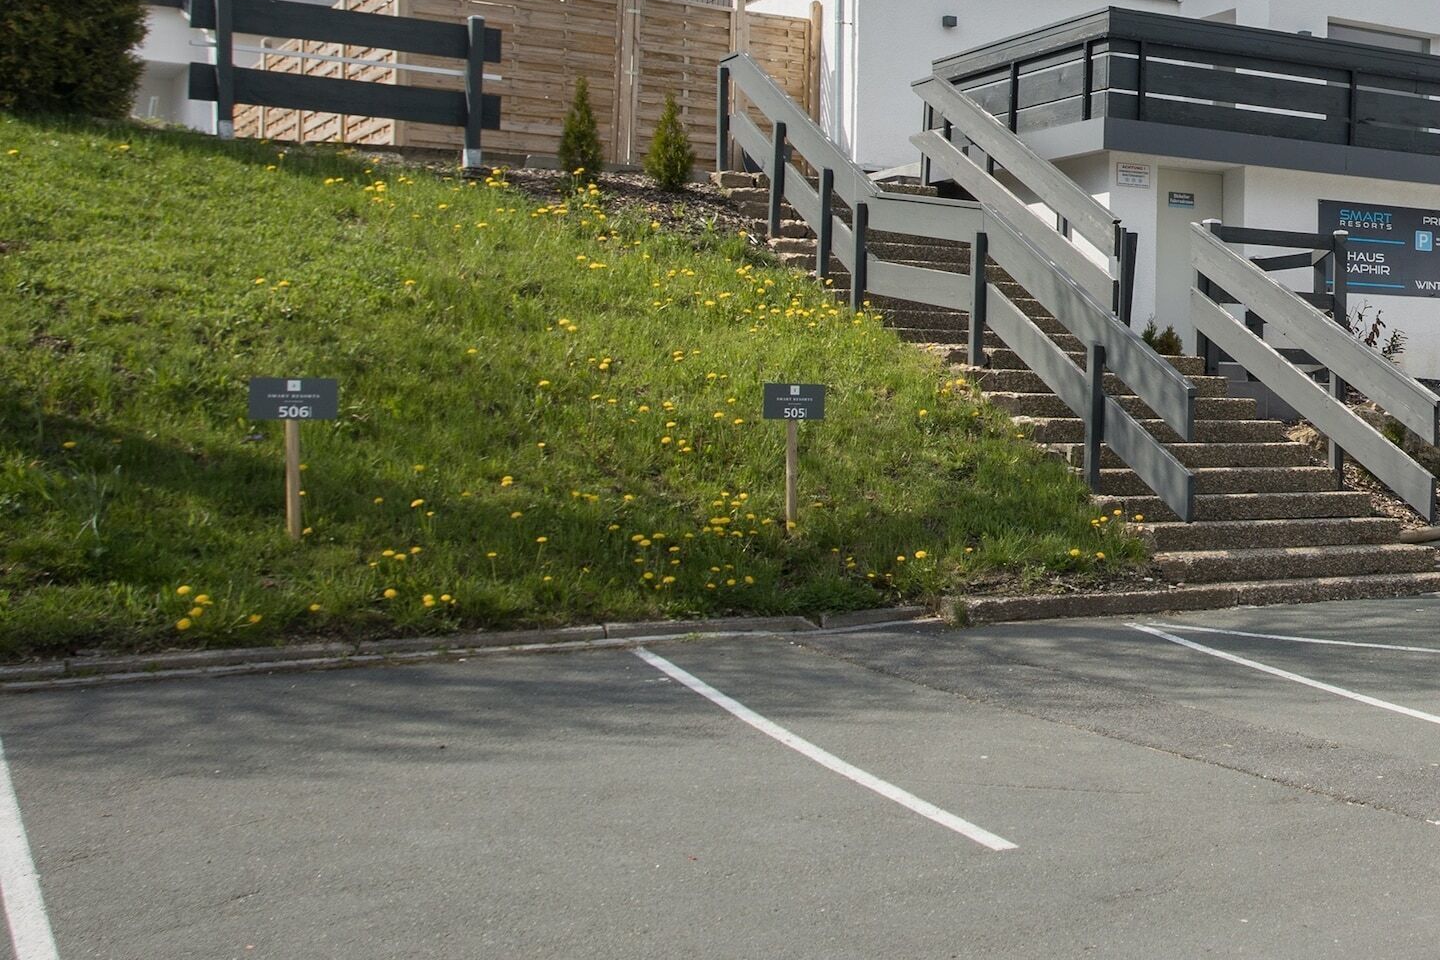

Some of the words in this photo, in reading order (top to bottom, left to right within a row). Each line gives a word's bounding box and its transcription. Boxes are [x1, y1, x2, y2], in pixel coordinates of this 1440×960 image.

[1339, 209, 1393, 223] SMART
[1339, 220, 1393, 230] RESORTS
[1346, 251, 1385, 263] HAUS
[278, 406, 309, 418] 506
[783, 408, 805, 418] 505
